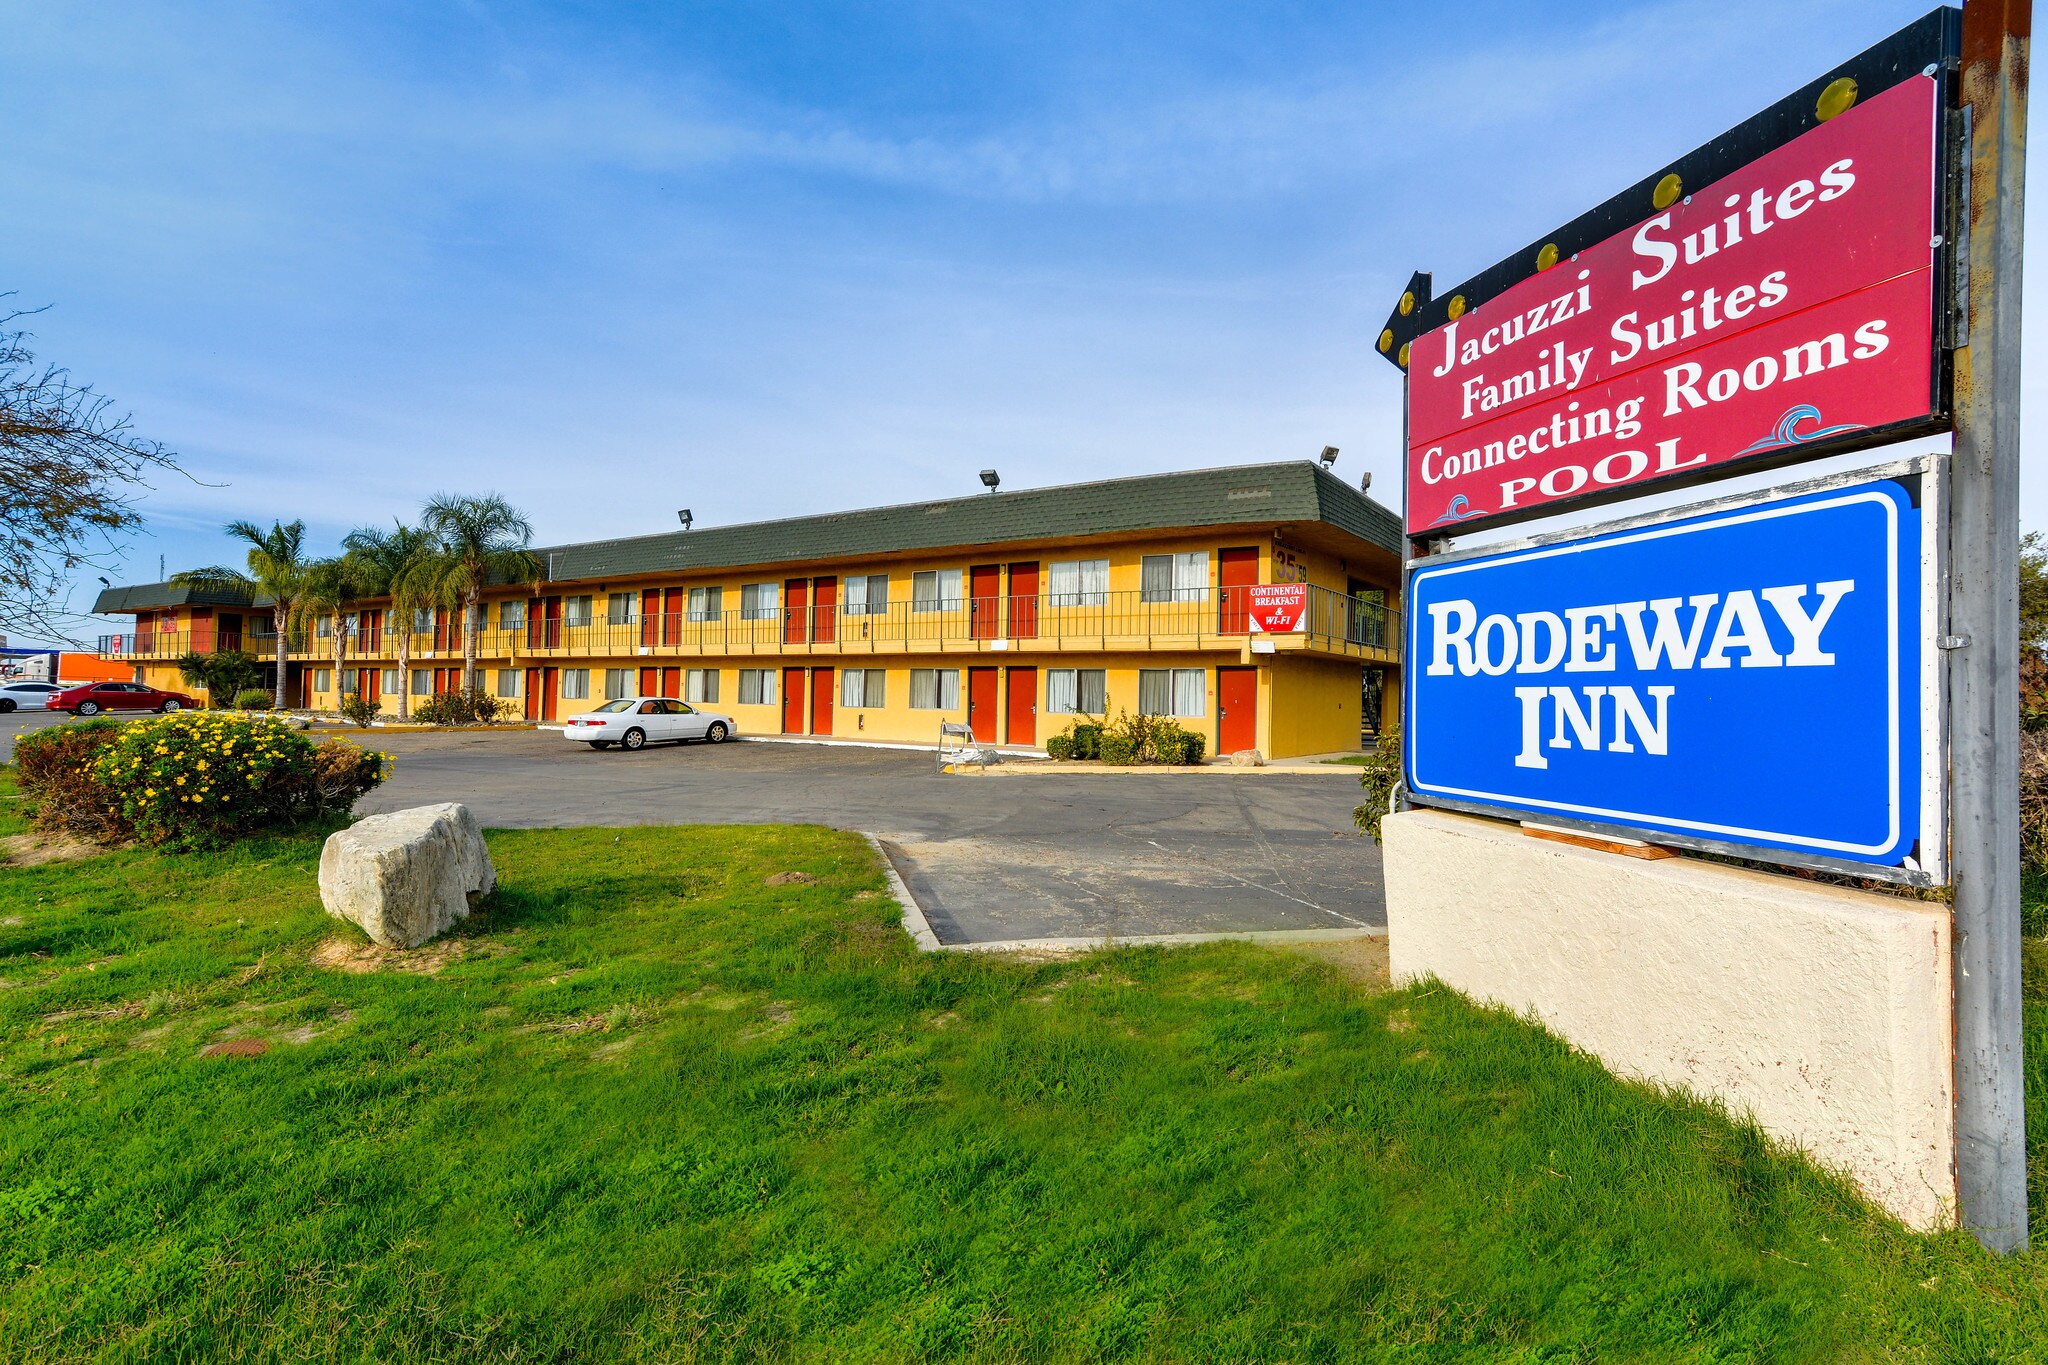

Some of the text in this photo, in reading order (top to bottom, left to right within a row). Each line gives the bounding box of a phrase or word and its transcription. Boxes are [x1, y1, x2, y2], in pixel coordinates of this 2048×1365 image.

[1433, 158, 1856, 378] Jacuzzi Suites
[1461, 270, 1788, 420] Family Suites
[1421, 319, 1890, 485] Connecting Rooms
[1499, 437, 1707, 509] POOL
[1250, 586, 1304, 596] CONTINENTAL
[1255, 596, 1300, 606] BREAKFAST
[1276, 550, 1296, 581] 35
[1265, 616, 1291, 625] WI-FI
[1275, 607, 1283, 615] &
[1426, 579, 1855, 677] RODEWAY
[1514, 685, 1676, 770] INN
